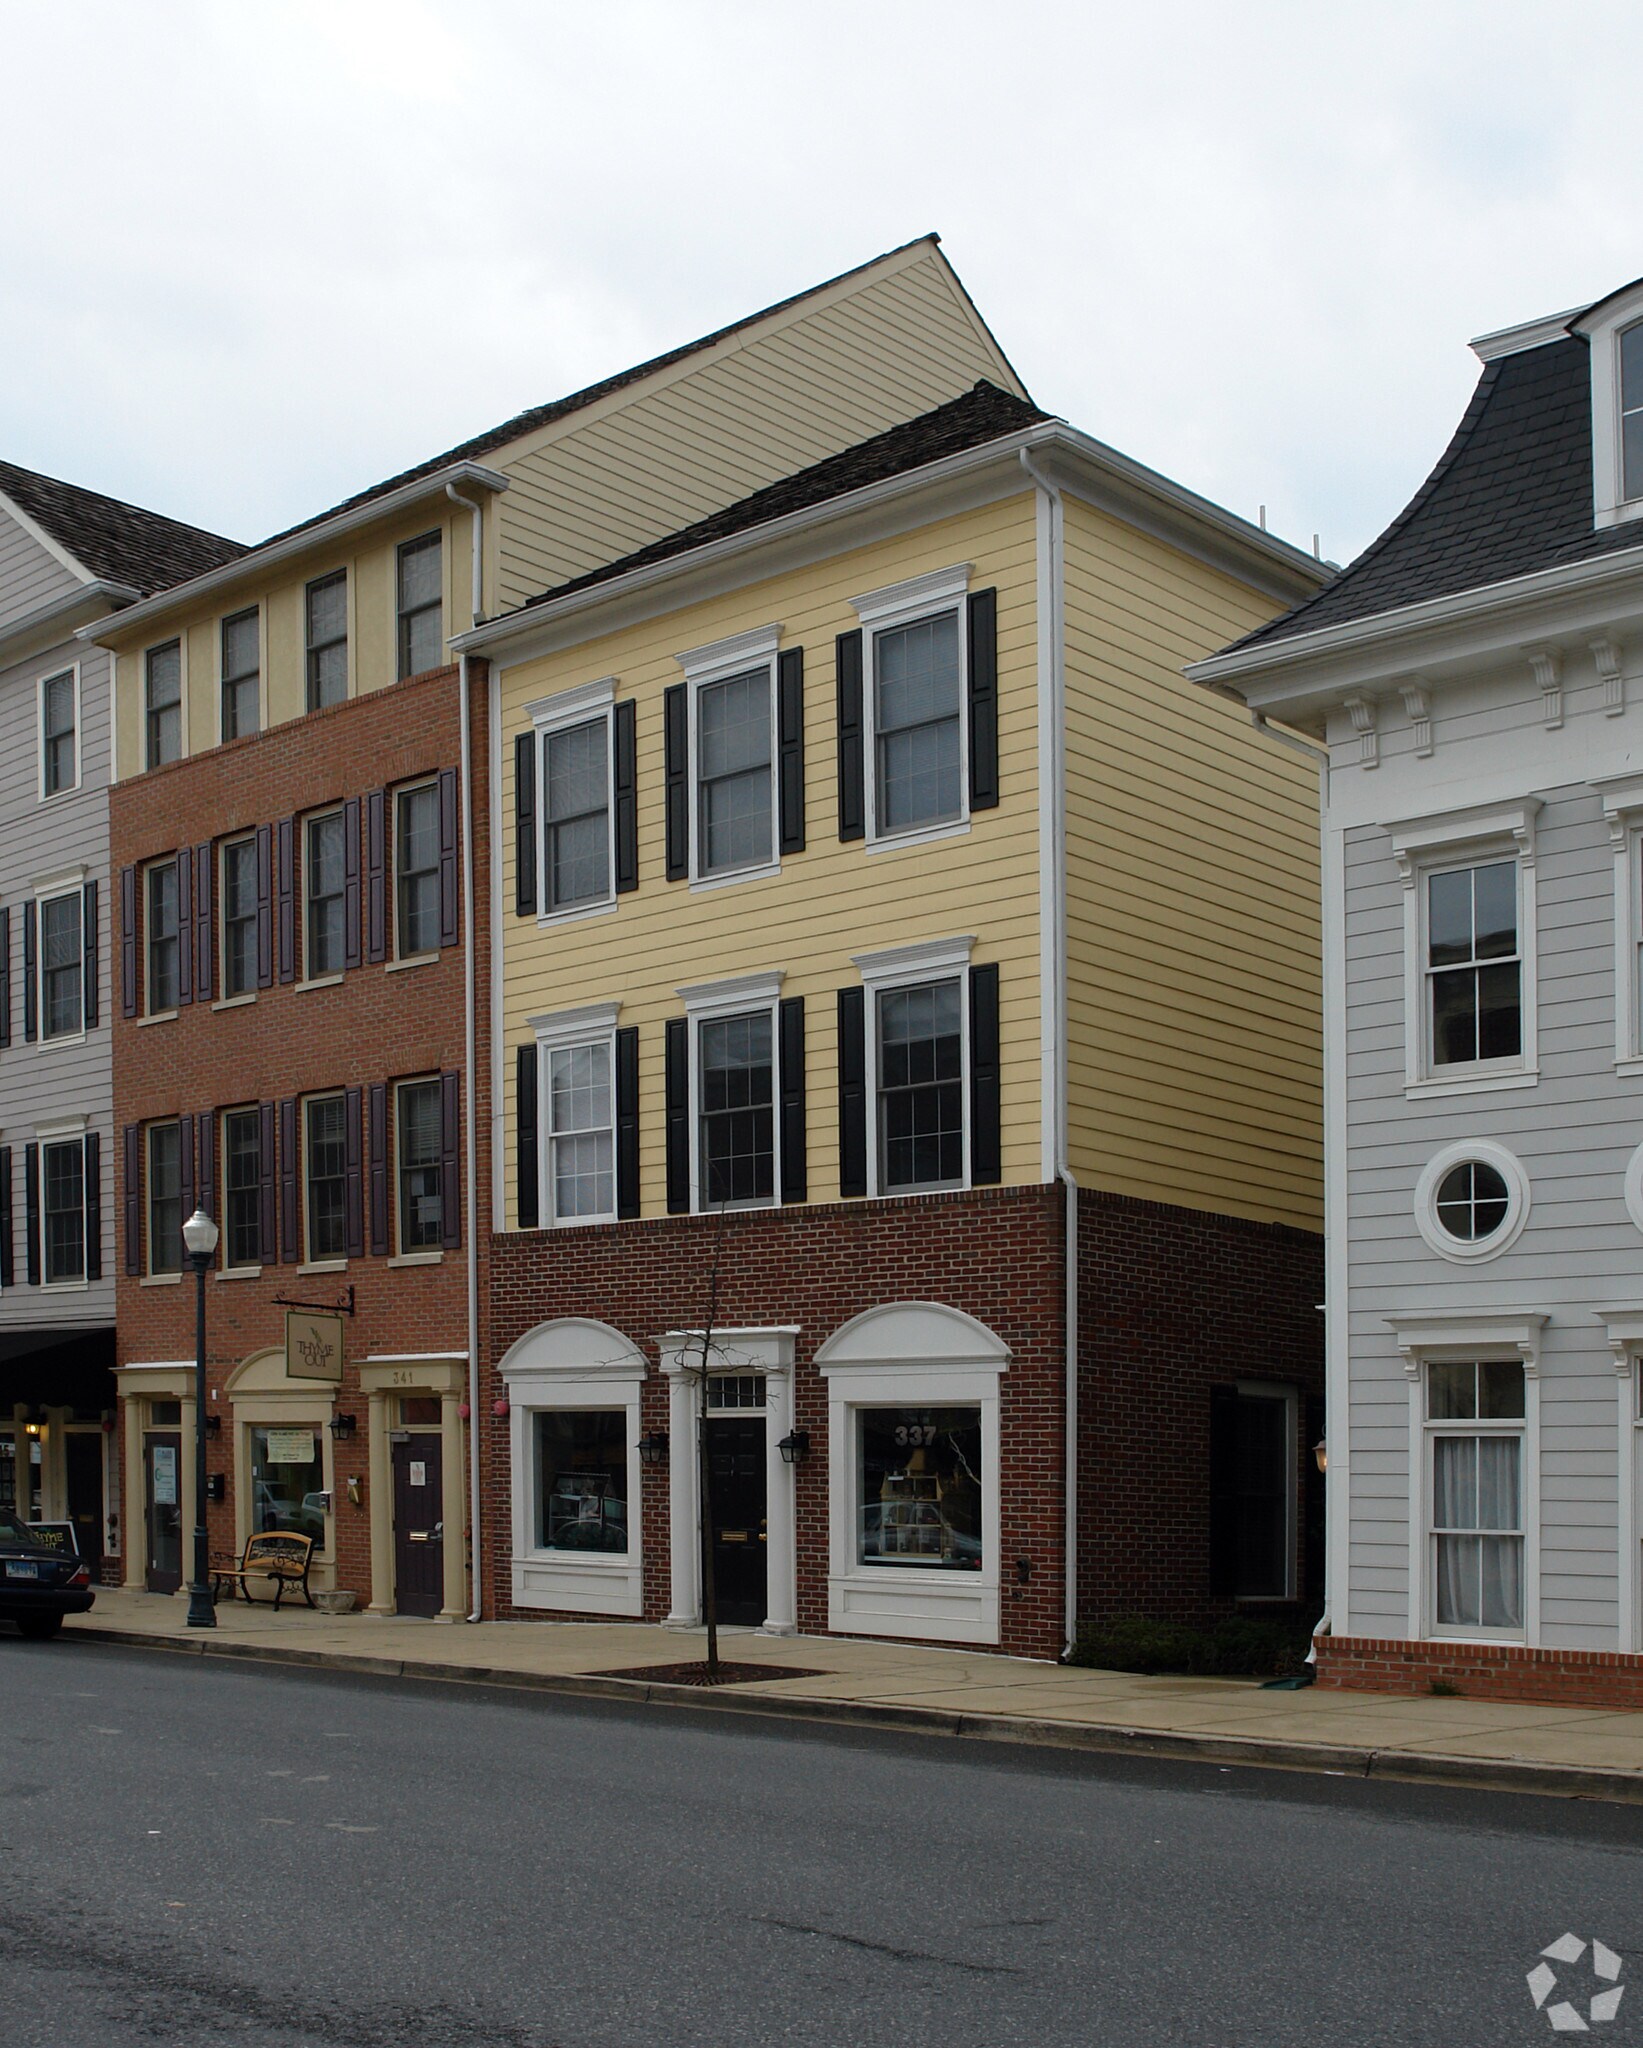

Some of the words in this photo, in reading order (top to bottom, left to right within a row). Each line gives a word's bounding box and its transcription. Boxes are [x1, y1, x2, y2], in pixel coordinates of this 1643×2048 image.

[297, 1341, 334, 1357] THYME
[304, 1353, 326, 1367] OUT
[393, 1371, 413, 1384] 341
[895, 1425, 937, 1446] 337
